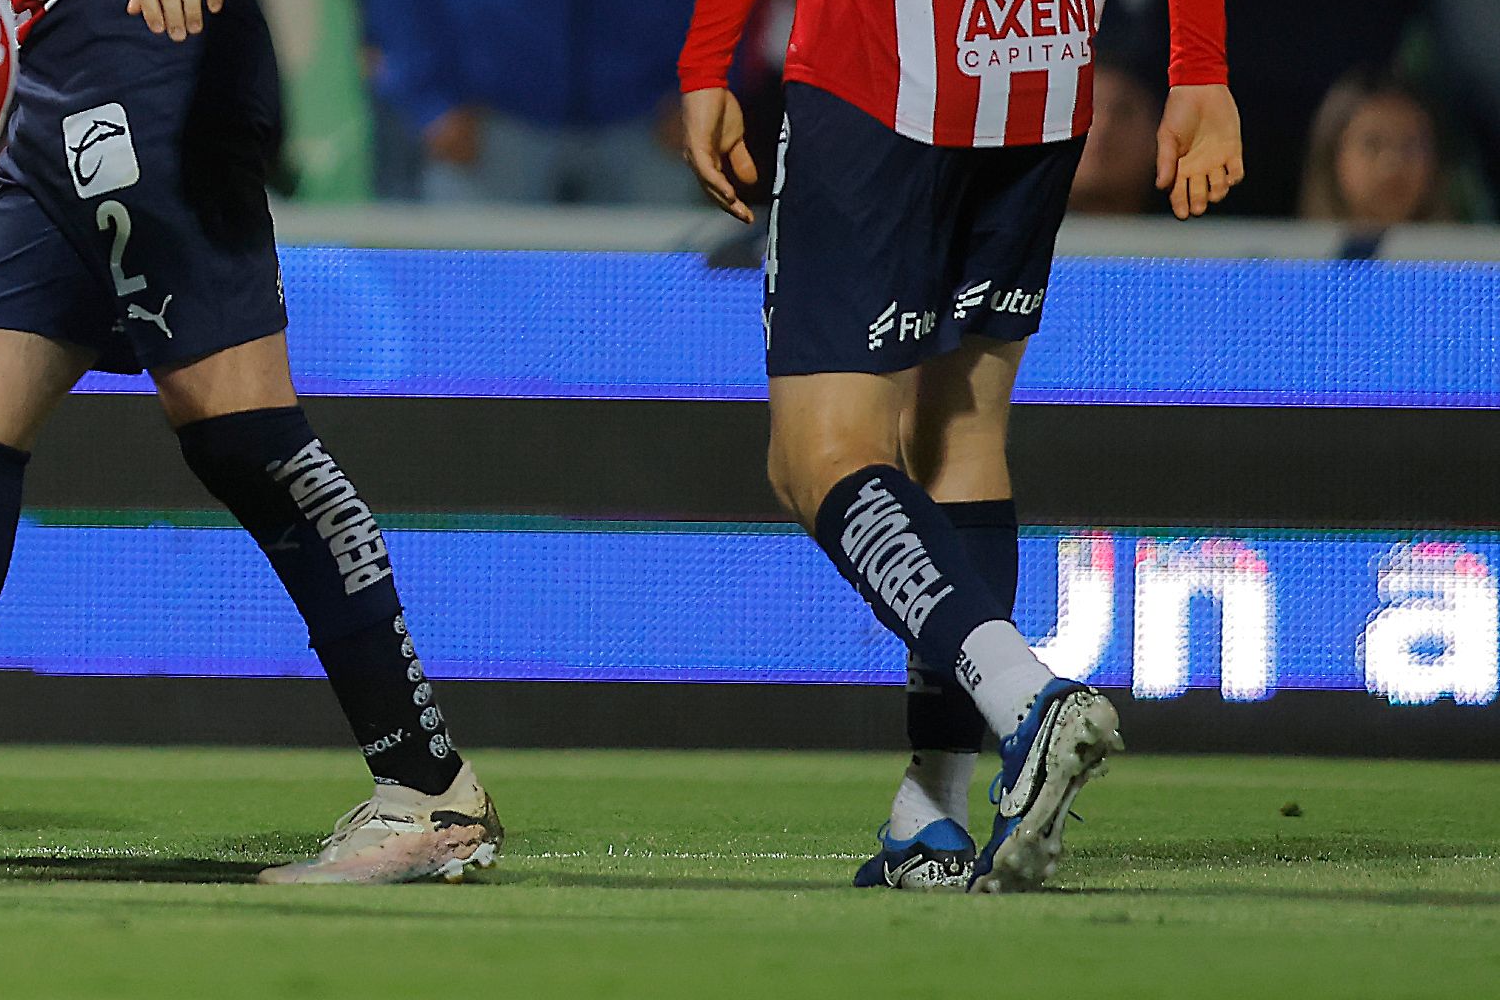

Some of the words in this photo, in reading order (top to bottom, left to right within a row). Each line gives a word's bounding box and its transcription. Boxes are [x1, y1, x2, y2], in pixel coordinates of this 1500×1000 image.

[964, 41, 1089, 68] CAPITAL
[96, 199, 148, 296] 2
[274, 437, 393, 597] PERDURA
[840, 477, 955, 640] PERDURA
